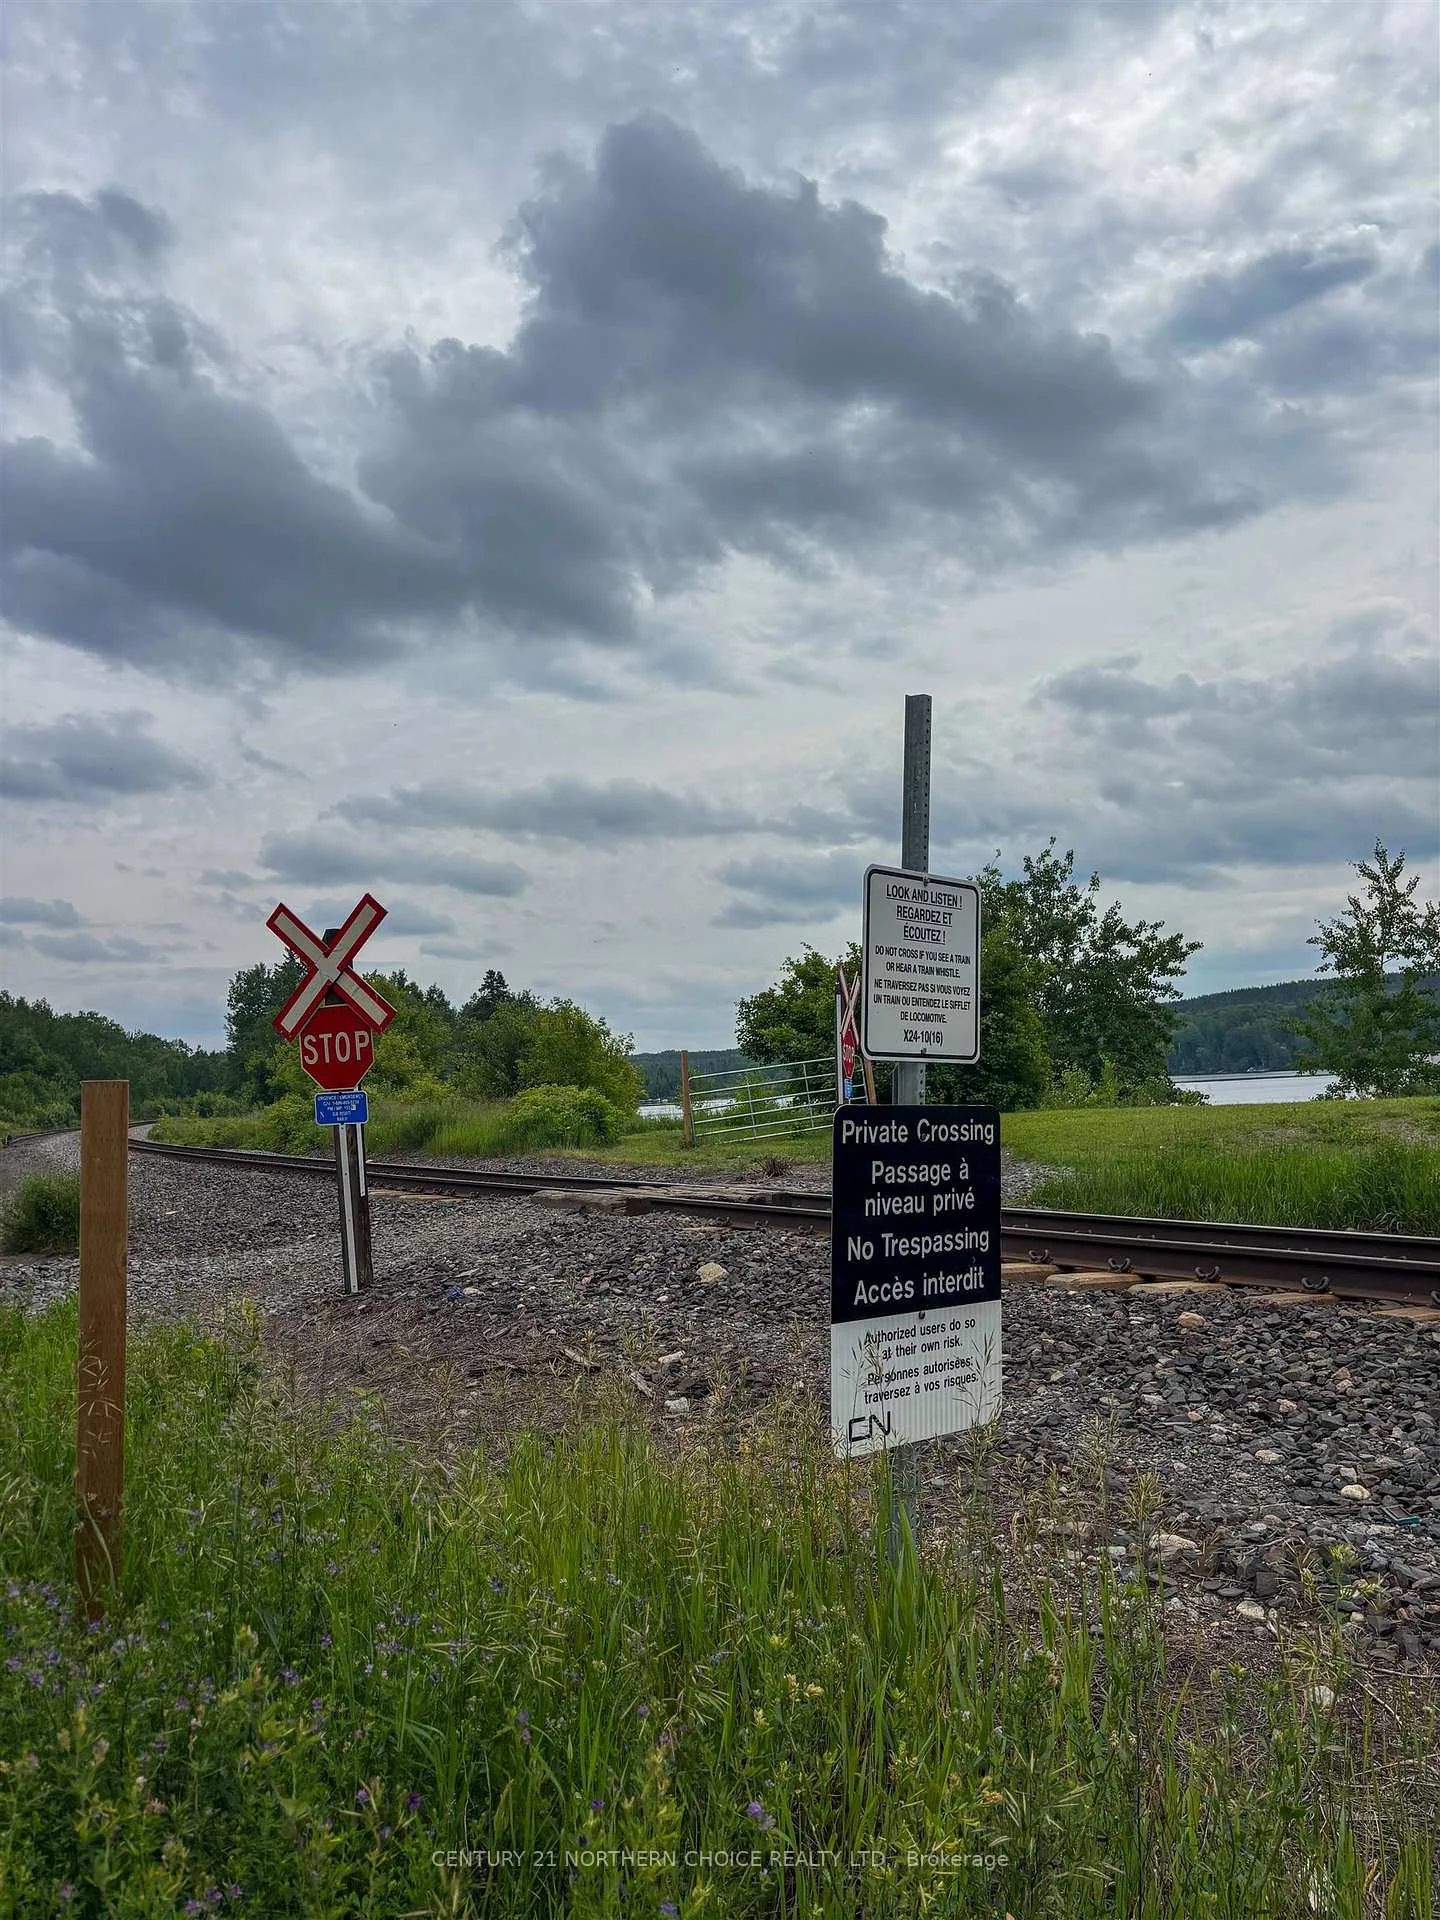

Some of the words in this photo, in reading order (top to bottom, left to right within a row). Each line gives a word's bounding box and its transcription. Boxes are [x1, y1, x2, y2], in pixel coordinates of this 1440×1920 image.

[886, 884, 910, 900] LOOK
[912, 888, 929, 902] AND
[931, 891, 958, 907] LISTEN
[896, 905, 941, 923] REGARDEZ
[943, 912, 953, 925] ET
[903, 922, 941, 941] ÉCOUTEZ
[875, 945, 884, 955] DO
[885, 946, 897, 957] NOT
[899, 948, 918, 959] CROSS
[919, 950, 924, 960] IF
[926, 951, 938, 961] YOU
[938, 952, 949, 962] SEE
[950, 954, 954, 963] A
[955, 954, 971, 965] TRAIN
[886, 961, 894, 971] OR
[896, 962, 912, 973] HEAR
[913, 964, 917, 974] A
[918, 964, 935, 976] TRAIN
[874, 979, 882, 989] NE
[884, 979, 917, 991] TRAVERSEZ
[918, 983, 929, 993] PAS
[930, 983, 936, 993] SI
[937, 984, 952, 995] VOUS
[953, 986, 971, 996] VOYEZ
[873, 994, 882, 1004] UN
[883, 994, 900, 1005] TRAIN
[902, 996, 910, 1006] OU
[912, 997, 940, 1008] ENTENDEZ
[942, 999, 948, 1009] LE
[950, 1000, 971, 1011] SIFFLET
[900, 1011, 908, 1021] DE
[303, 1030, 370, 1065] STOP
[903, 1029, 943, 1046] X24-10(16)
[842, 1119, 908, 1144] Private
[916, 1118, 994, 1145] Crossing
[871, 1160, 951, 1186] Passage
[959, 1157, 969, 1180] à
[865, 1191, 925, 1217] niveau
[933, 1187, 975, 1216] privé
[847, 1236, 874, 1262] No
[882, 1226, 989, 1259] Trespassing
[853, 1275, 915, 1306] Accès
[923, 1266, 985, 1296] interdit
[863, 1324, 916, 1344] Authorized
[920, 1322, 946, 1336] users
[949, 1318, 961, 1331] do
[964, 1318, 976, 1329] so
[882, 1346, 892, 1360] at
[896, 1342, 917, 1358] their
[921, 1340, 940, 1353] own
[943, 1335, 963, 1349] risk.
[864, 1386, 911, 1404] traversez
[914, 1382, 920, 1394] à
[924, 1380, 940, 1392] vos
[944, 1372, 979, 1388] risques.
[867, 1367, 920, 1386] Personnes
[849, 1411, 891, 1442] CN
